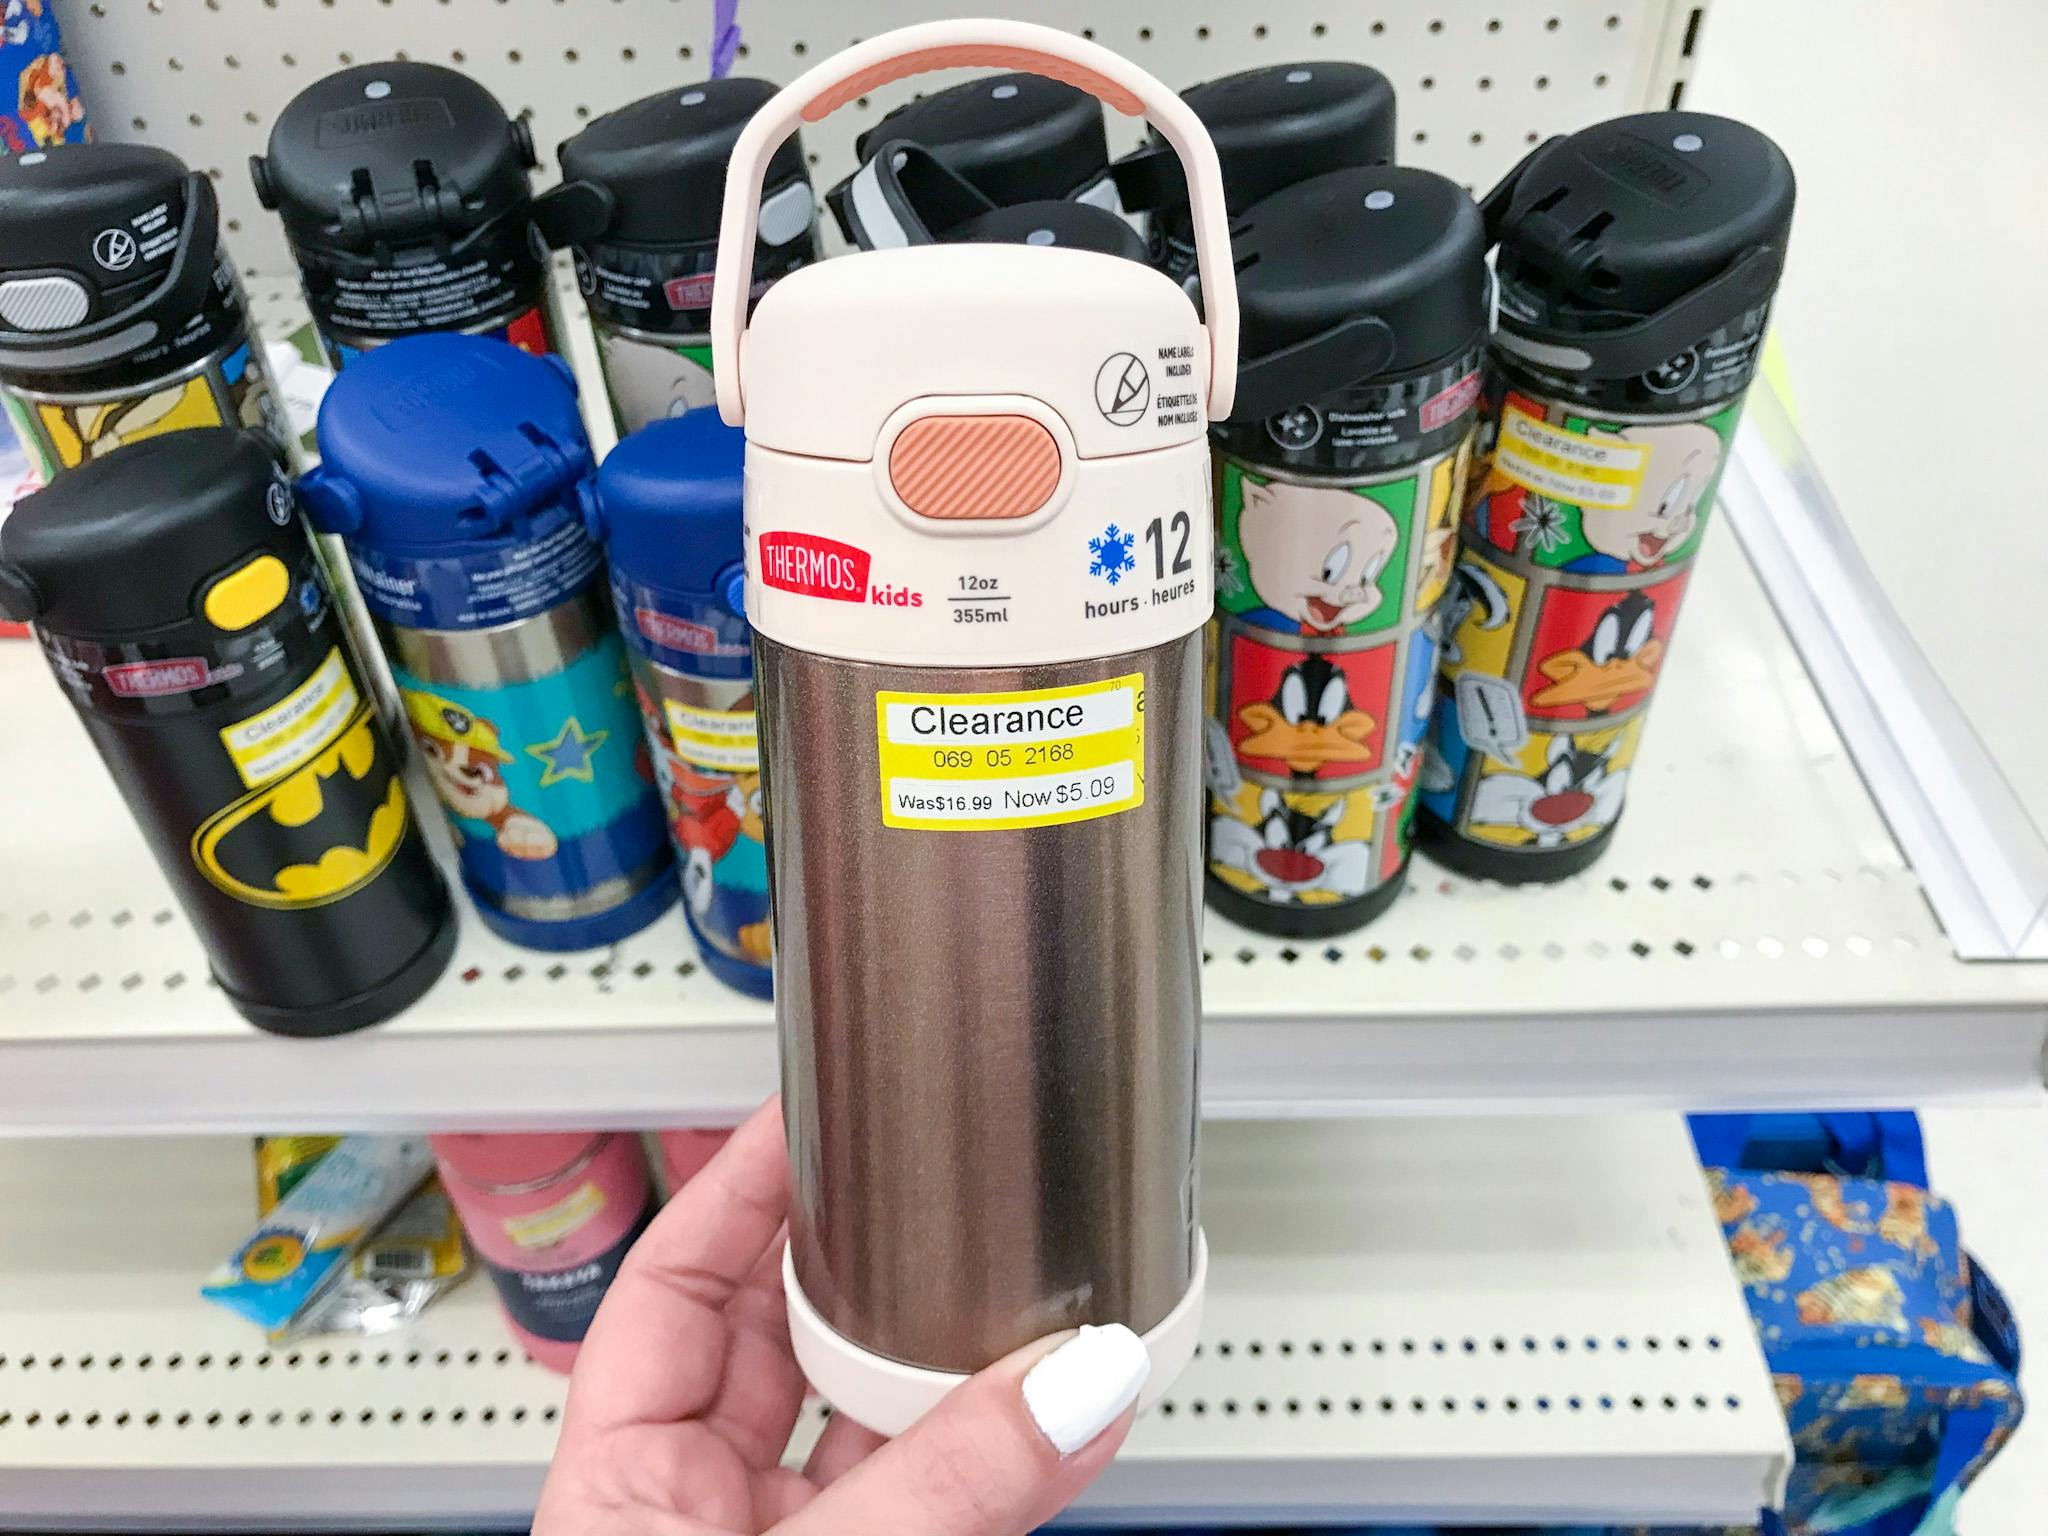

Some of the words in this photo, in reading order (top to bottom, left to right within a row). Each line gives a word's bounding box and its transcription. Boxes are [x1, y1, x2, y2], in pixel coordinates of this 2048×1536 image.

[1158, 347, 1177, 360] NAME
[1165, 364, 1191, 377] INCLUDED
[1158, 413, 1174, 428] NOM
[1516, 419, 1607, 462] Clearance
[1145, 510, 1192, 581] 12
[766, 544, 857, 592] THERMOS
[872, 584, 923, 608] kids
[958, 575, 999, 590] 12oz
[1085, 597, 1140, 619] hours
[1152, 579, 1195, 606] heures
[953, 607, 1009, 623] 355ml
[911, 704, 1084, 735] Clearance
[933, 750, 973, 768] 069
[986, 749, 1012, 767] 05
[1025, 743, 1074, 765] 2168
[1004, 789, 1052, 810] Now
[1056, 776, 1115, 805] $5.09
